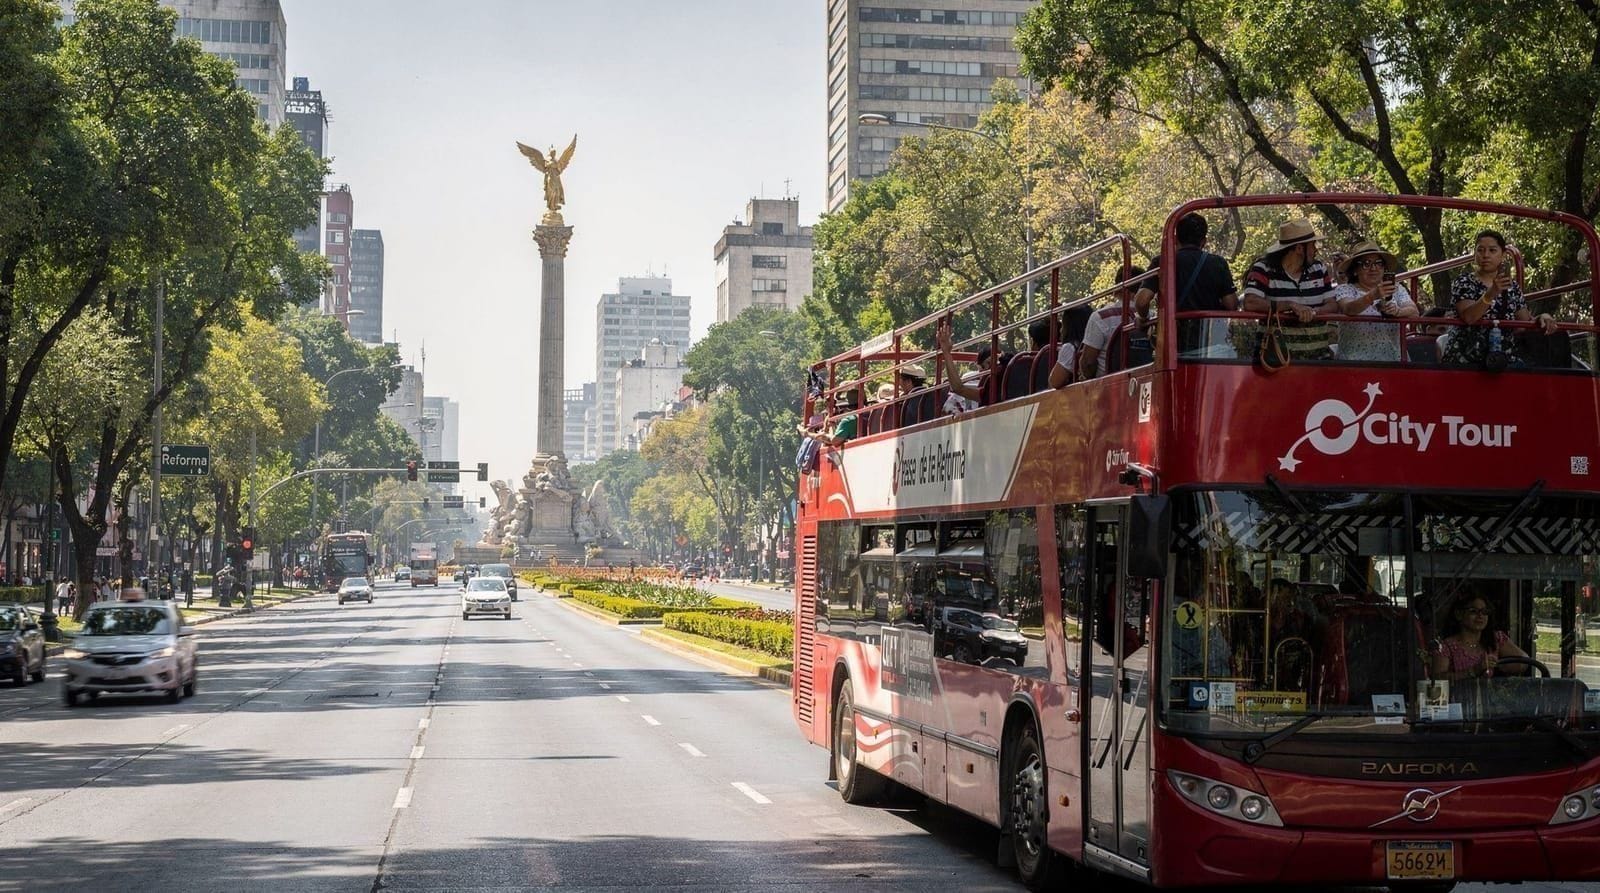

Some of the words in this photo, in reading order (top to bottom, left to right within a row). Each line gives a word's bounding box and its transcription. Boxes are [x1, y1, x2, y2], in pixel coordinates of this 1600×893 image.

[1362, 412, 1436, 452] City
[1442, 415, 1517, 447] Tour
[162, 453, 208, 466] Reforma
[936, 439, 966, 492] Reforma
